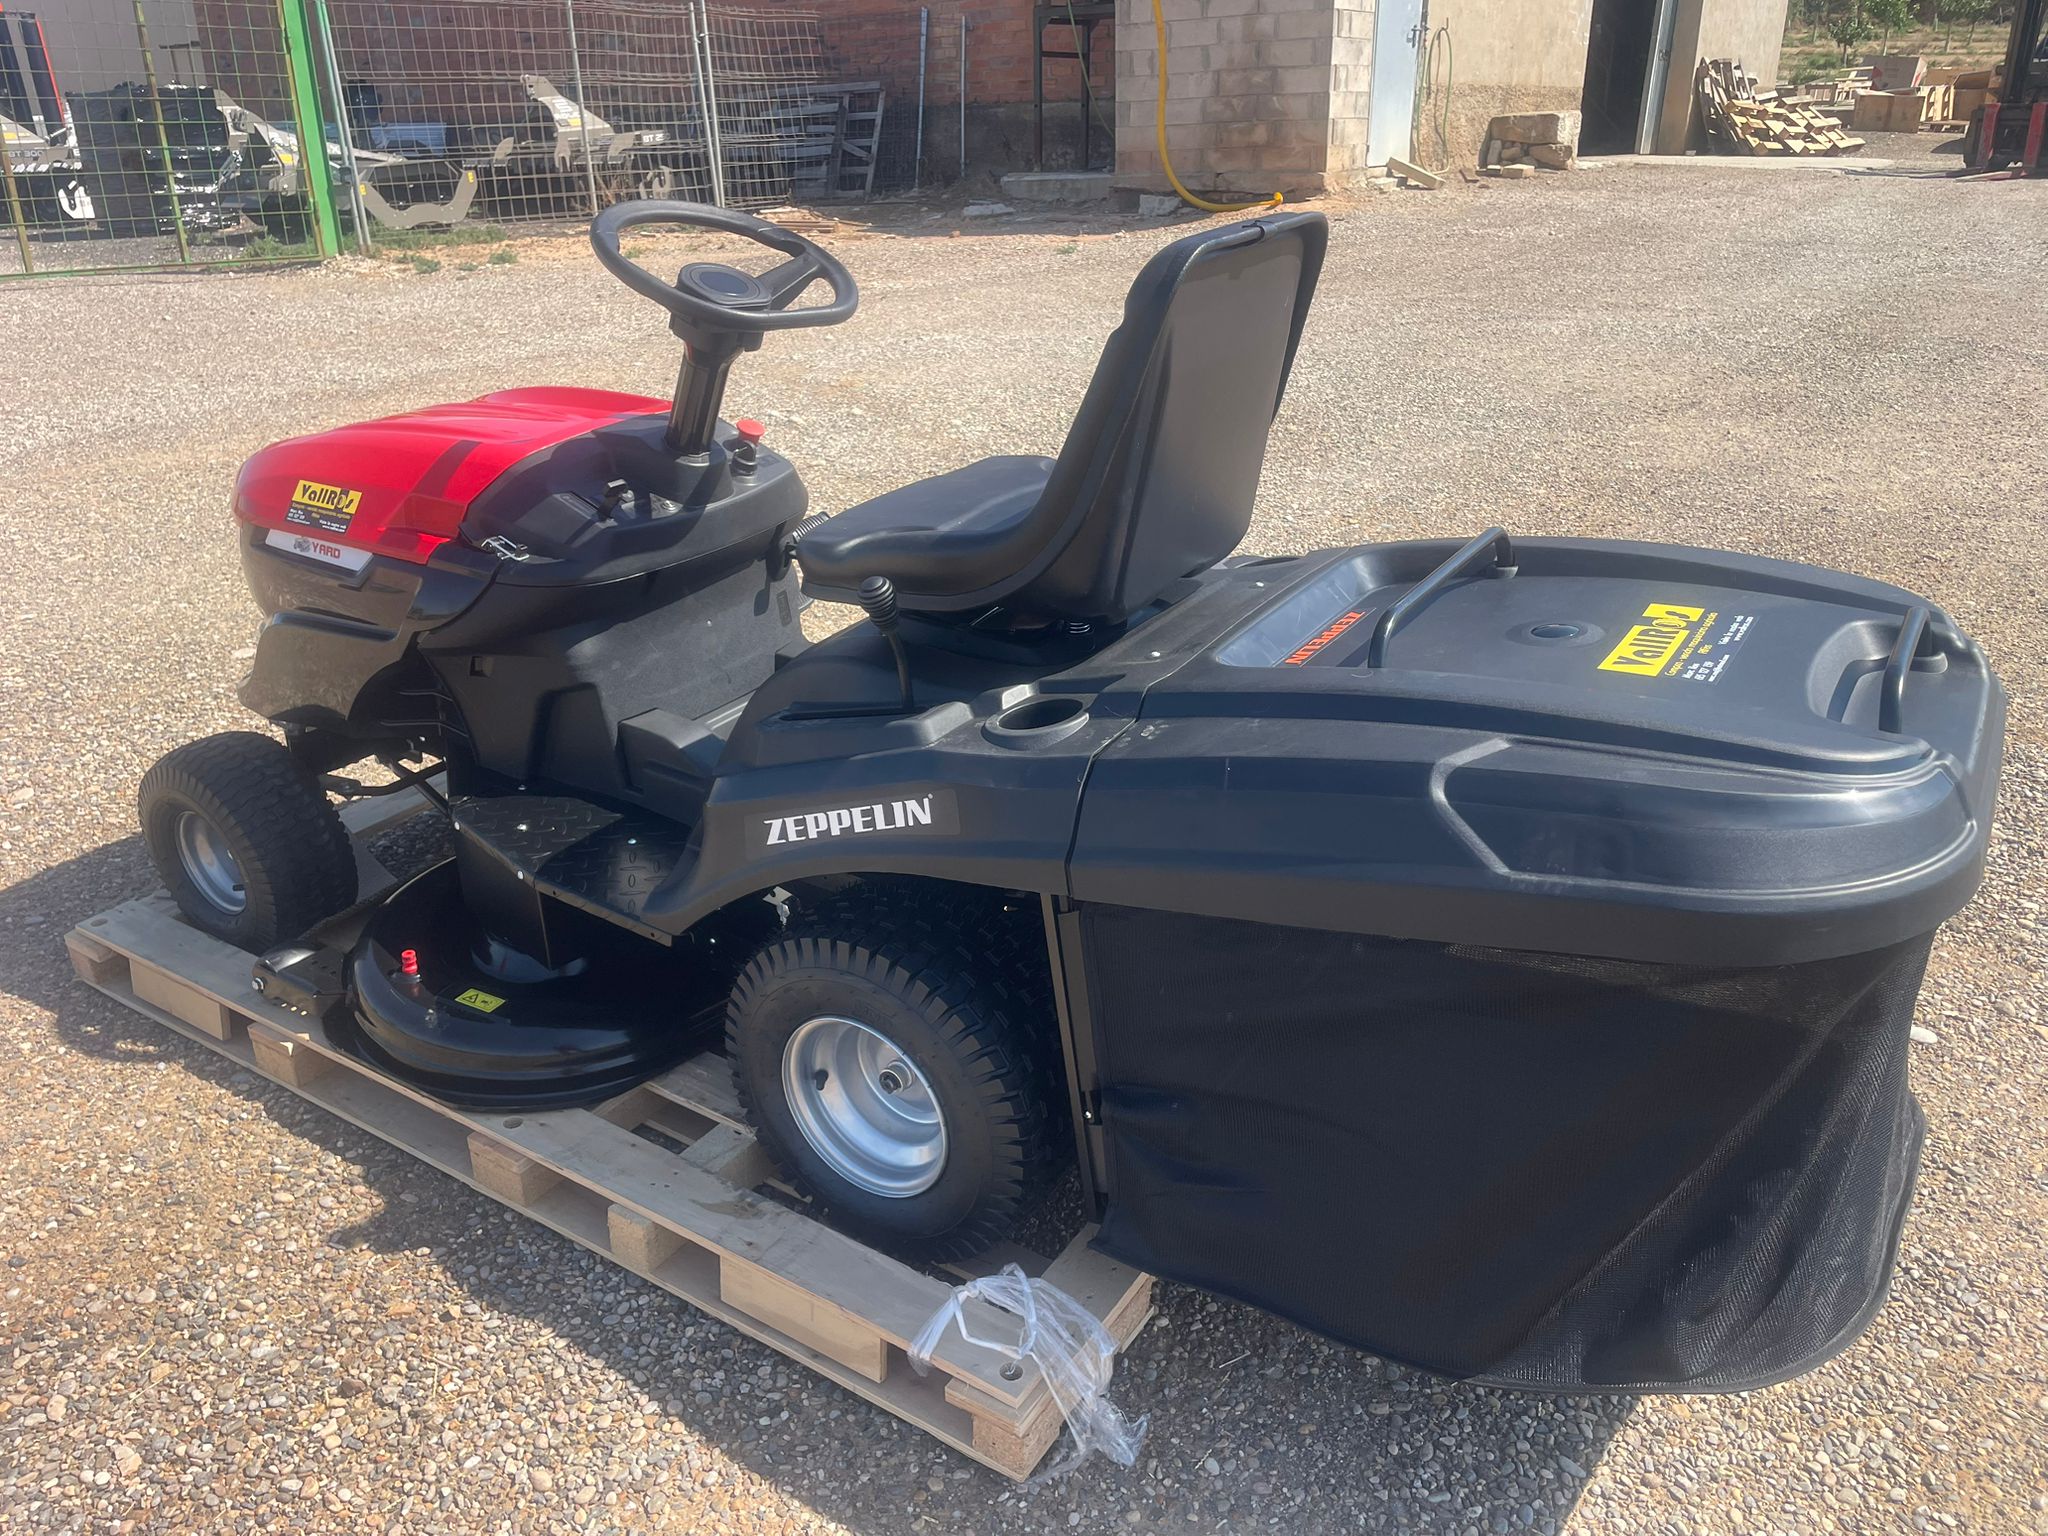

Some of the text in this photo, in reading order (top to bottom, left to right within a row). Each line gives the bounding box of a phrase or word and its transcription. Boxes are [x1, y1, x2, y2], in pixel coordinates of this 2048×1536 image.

[302, 484, 354, 509] VallRos
[312, 541, 341, 559] YARD
[1284, 611, 1366, 665] ZEPPELIN
[1612, 610, 1691, 666] VallRos
[763, 796, 933, 846] ZEPPELIN
